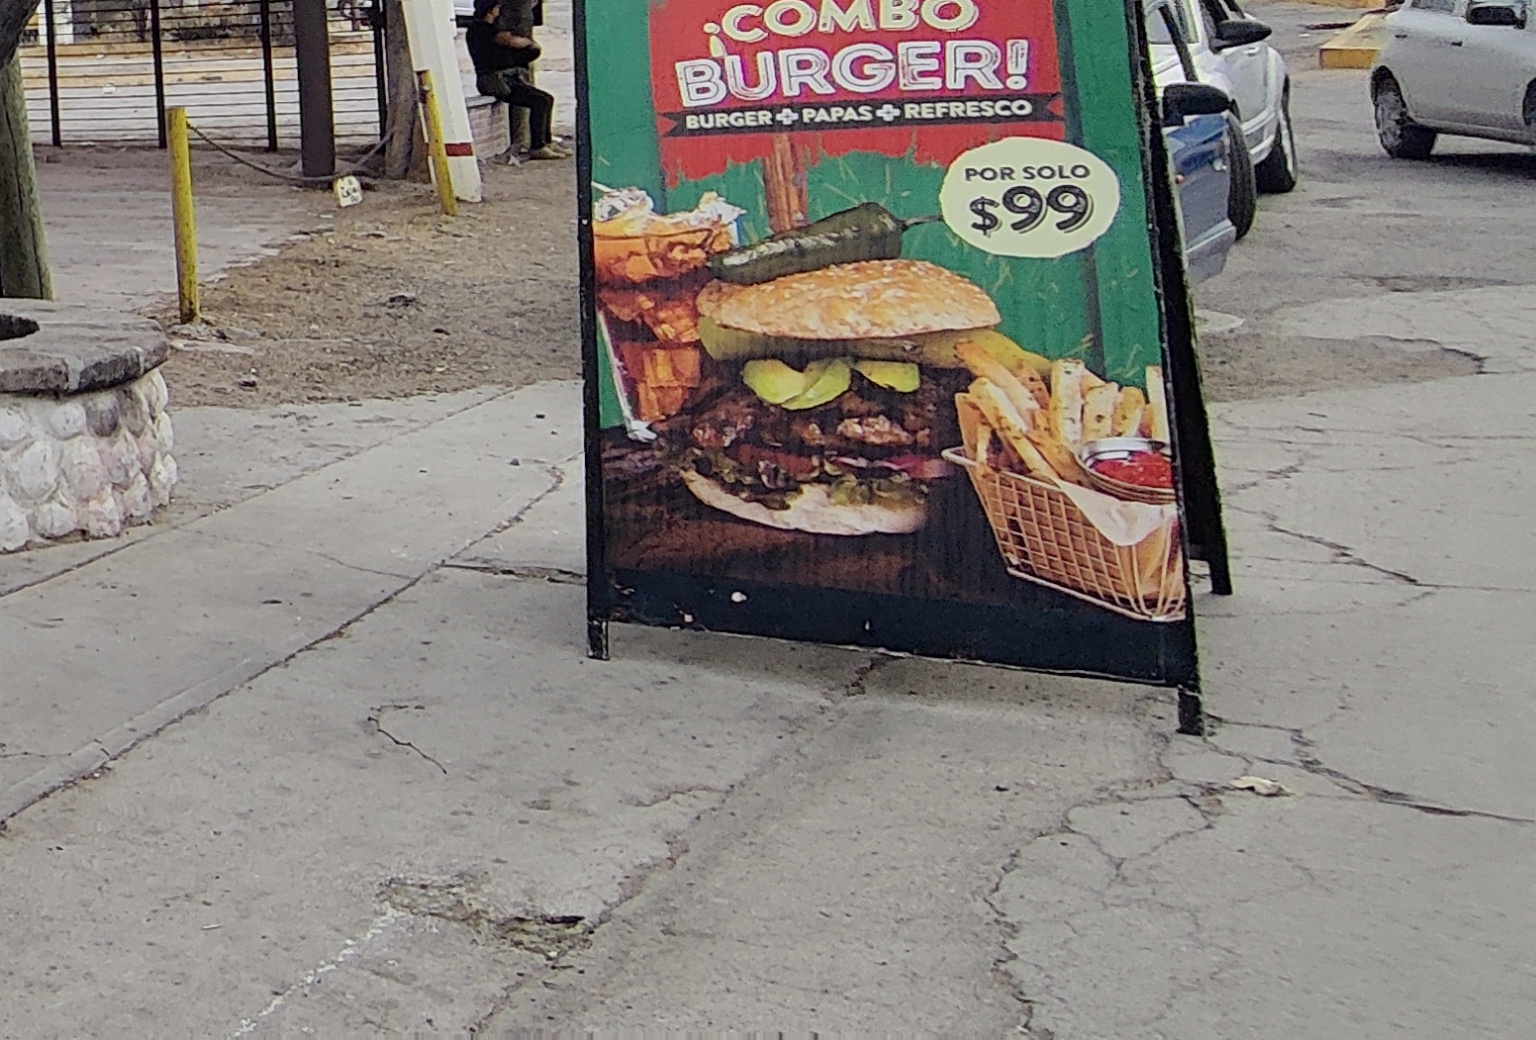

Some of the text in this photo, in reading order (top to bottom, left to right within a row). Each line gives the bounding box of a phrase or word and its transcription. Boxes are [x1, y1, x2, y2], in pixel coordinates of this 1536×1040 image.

[675, 39, 1029, 108] BURGER!
[685, 111, 773, 130] BURGER
[801, 105, 874, 124] PAPAS
[904, 99, 1034, 120] REFRESCO
[965, 164, 1091, 182] POR SOLO
[969, 184, 1095, 239] $99
